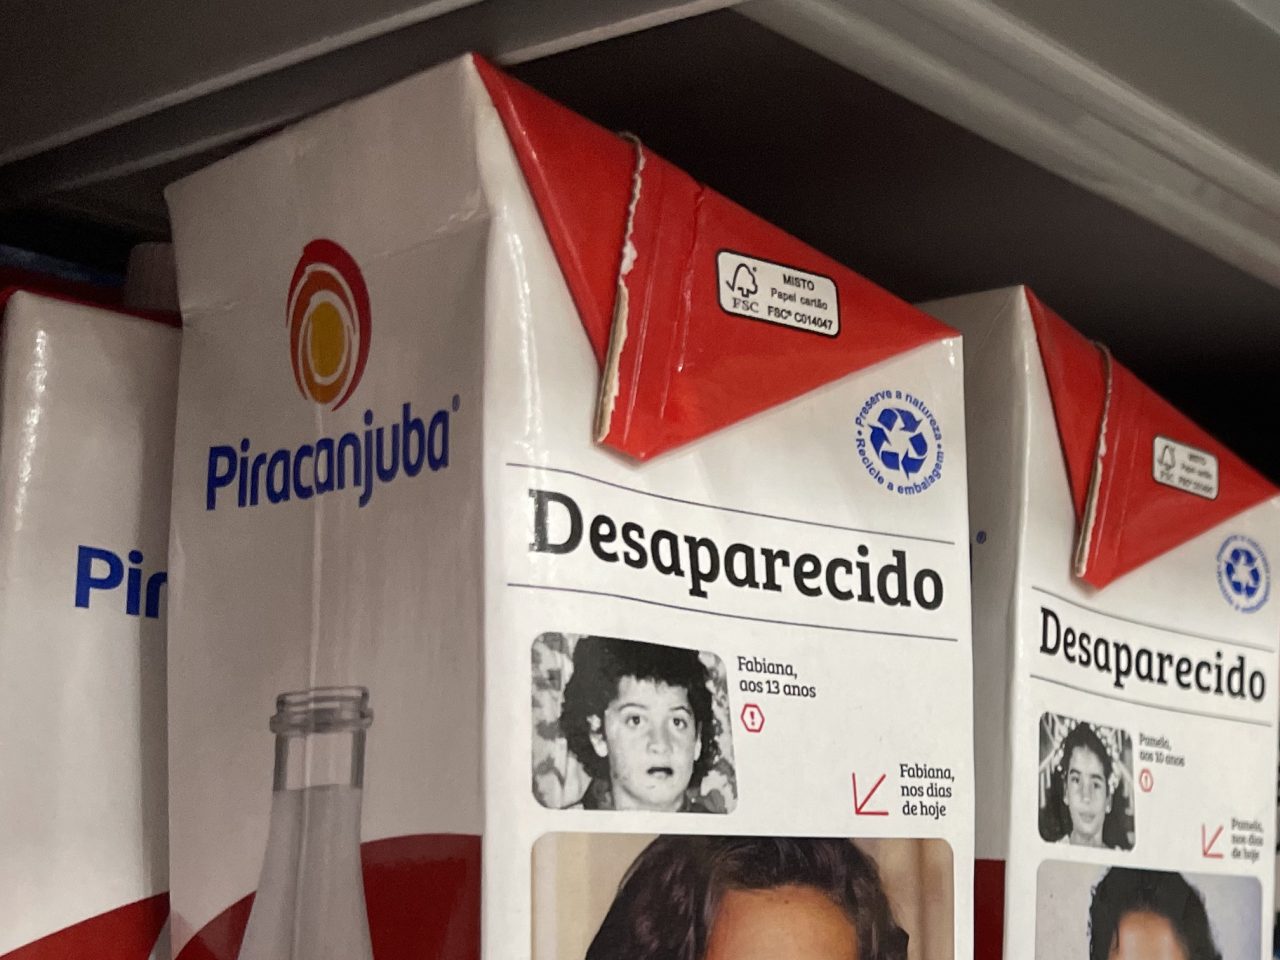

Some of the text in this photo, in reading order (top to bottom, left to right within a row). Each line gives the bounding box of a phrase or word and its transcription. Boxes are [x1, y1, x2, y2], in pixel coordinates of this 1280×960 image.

[782, 273, 815, 291] MISTO
[732, 297, 759, 313] FSC
[770, 288, 796, 303] Papel
[794, 312, 833, 330] C014047
[855, 390, 942, 441] Preserve natureza
[206, 402, 450, 511] Piracanjuba
[856, 438, 944, 495] Recicle embalagem
[528, 488, 944, 610] Desaparecido
[74, 545, 168, 619] Pir
[1040, 606, 1265, 701] Desaparecido
[737, 656, 798, 679] Fabiana,
[739, 679, 816, 698] aos 13 anos
[900, 764, 955, 782] Fabiana,
[900, 783, 952, 798] nos dias
[902, 802, 946, 820] de hoje
